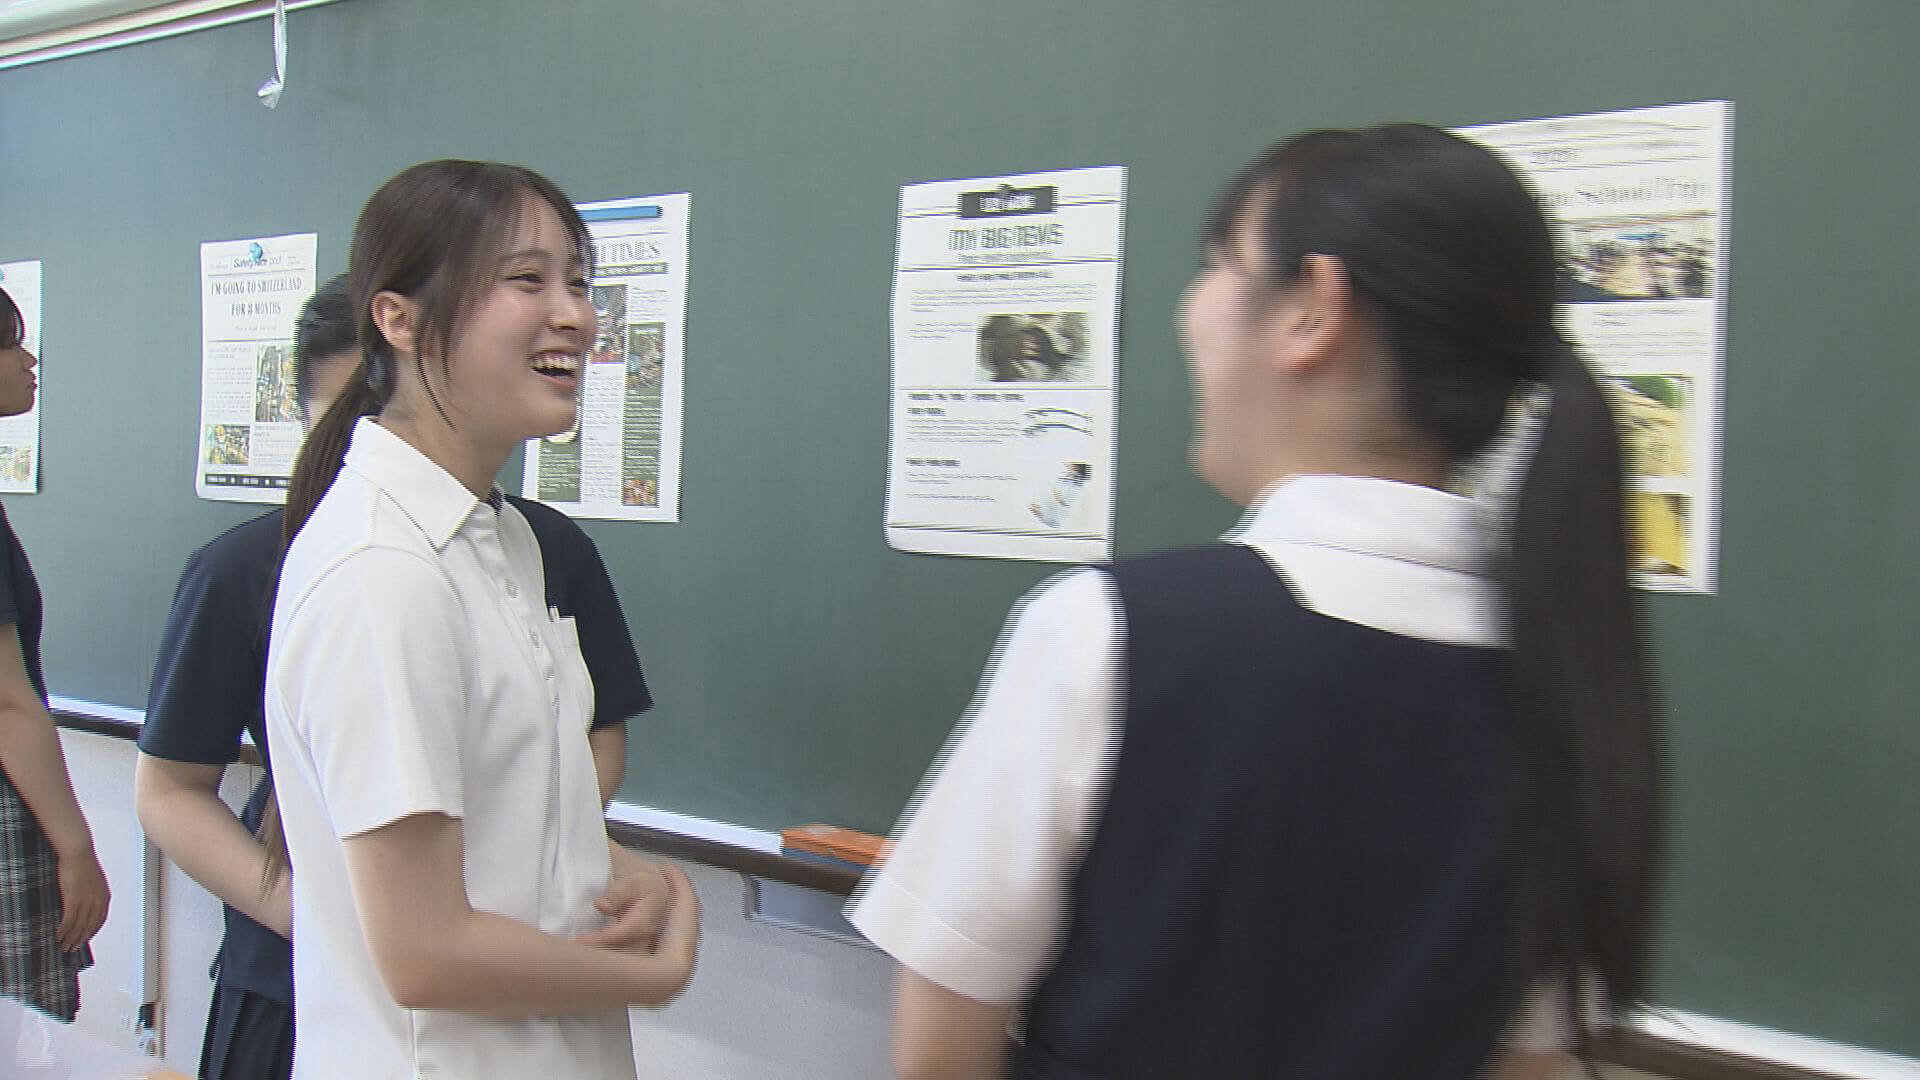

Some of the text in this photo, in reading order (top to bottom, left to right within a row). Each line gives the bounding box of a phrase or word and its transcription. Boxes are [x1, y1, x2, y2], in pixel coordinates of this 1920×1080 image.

[981, 227, 1012, 248] BIG
[1014, 223, 1064, 246] NEWS
[223, 281, 245, 295] GOING
[247, 280, 257, 294] TO
[258, 277, 302, 293] SWITZERLAND
[231, 303, 246, 317] FOR
[255, 300, 281, 315] MONTHS
